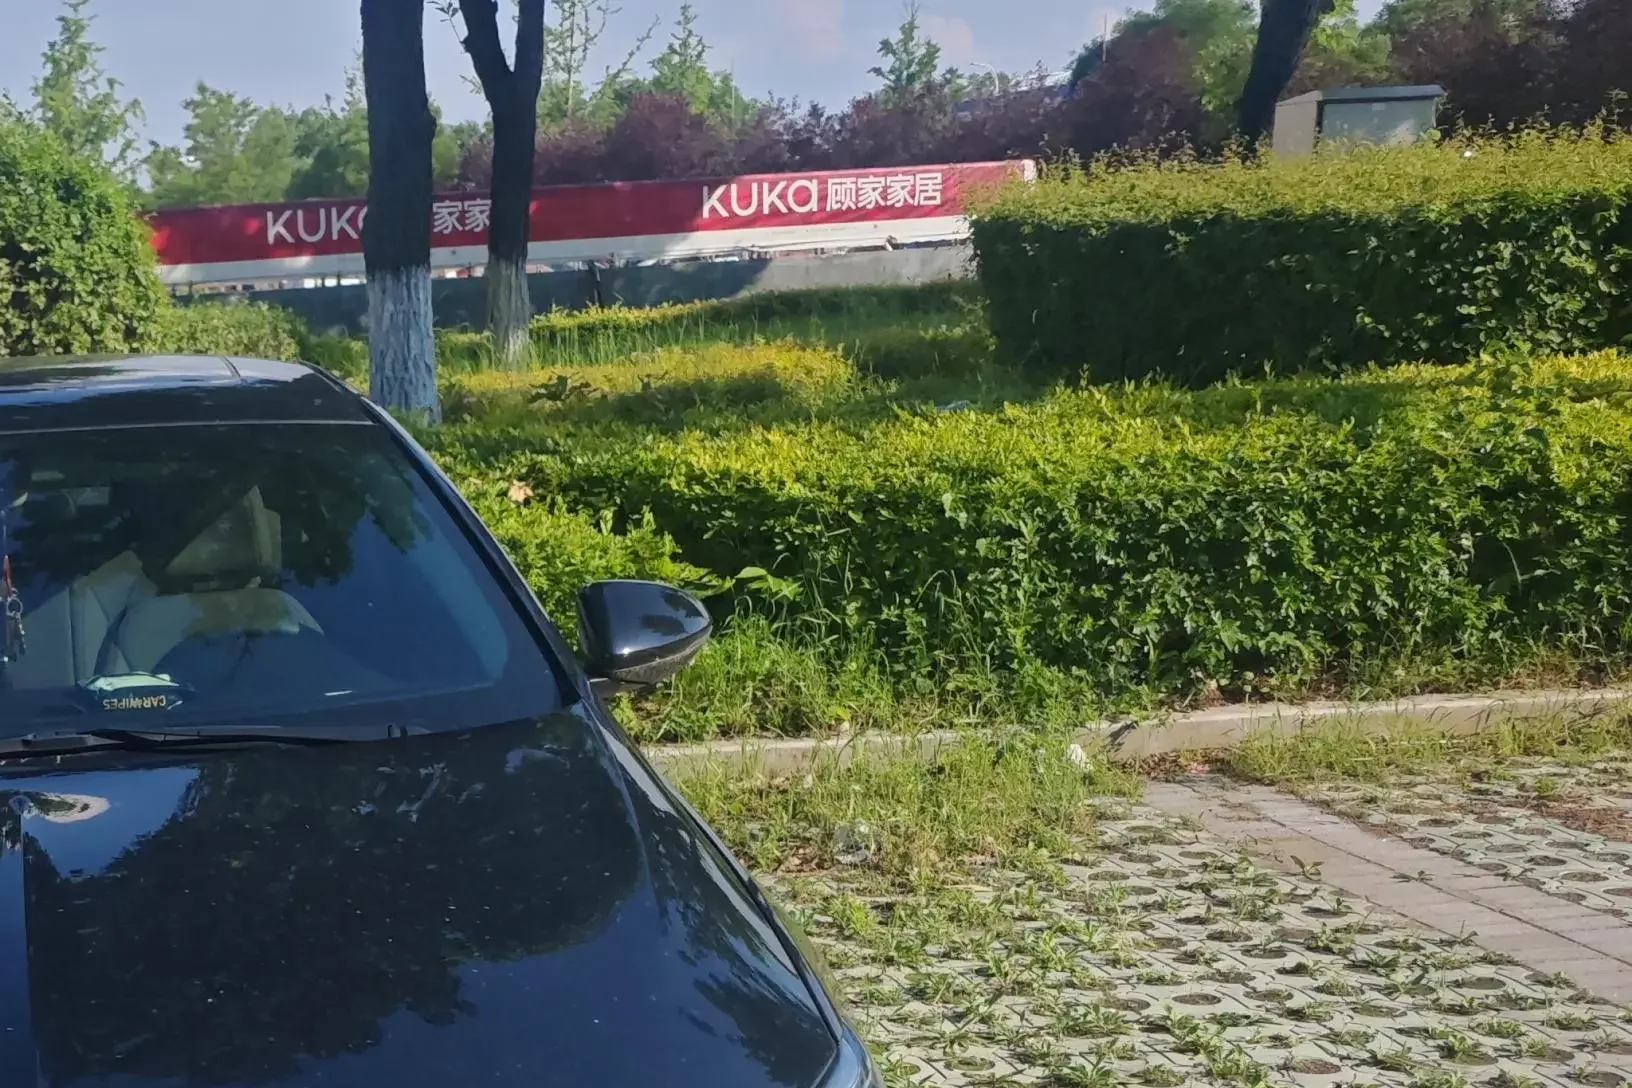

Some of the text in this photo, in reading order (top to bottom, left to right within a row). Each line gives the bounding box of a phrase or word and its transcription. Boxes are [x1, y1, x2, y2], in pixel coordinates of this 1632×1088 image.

[825, 172, 944, 212] 顾家家居
[432, 199, 491, 235] 家家
